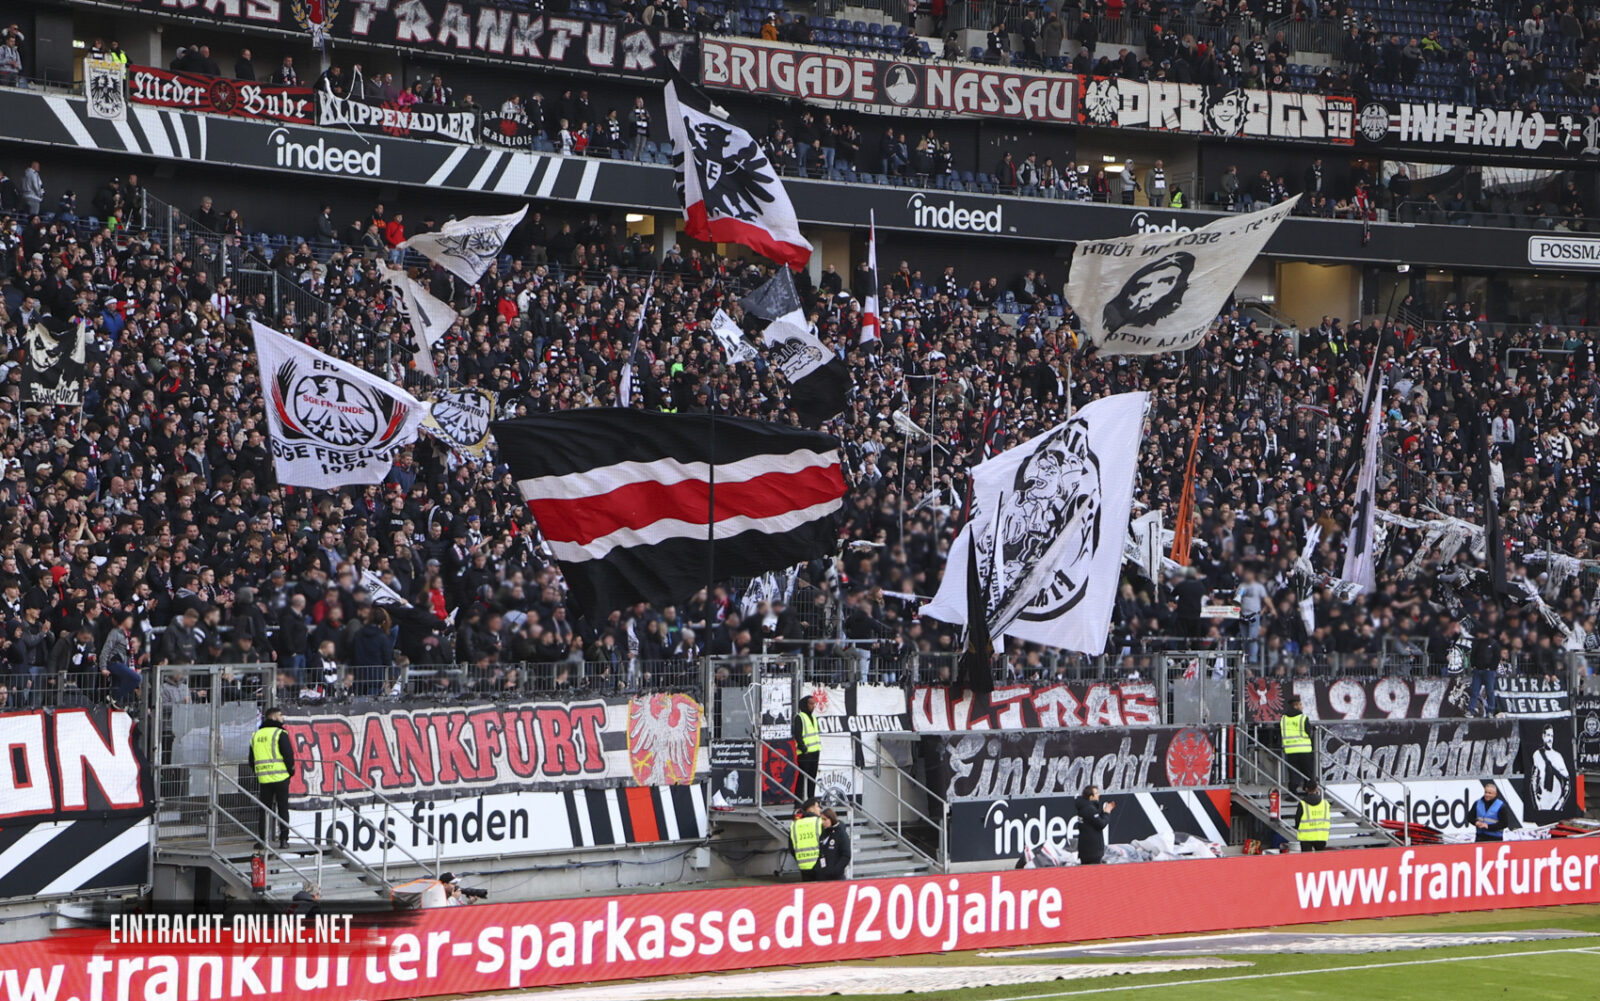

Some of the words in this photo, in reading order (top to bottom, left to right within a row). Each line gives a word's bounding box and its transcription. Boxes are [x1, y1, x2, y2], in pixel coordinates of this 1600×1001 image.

[351, 0, 695, 72] FRANKFURT
[240, 85, 308, 118] Bube
[703, 42, 877, 102] BRIGADE
[925, 67, 1074, 121] NASSAU
[318, 90, 475, 144] KLIPPENADLER
[834, 101, 951, 118] HOOLIGANS
[1328, 111, 1352, 138] 99
[1400, 103, 1546, 150] INFERNO
[274, 133, 382, 177] indeed
[913, 199, 1003, 233] indeed
[271, 438, 311, 461] SGE
[321, 459, 368, 475] 1994
[1293, 676, 1450, 720] 1997
[1498, 677, 1562, 691] ULTRAS
[1506, 698, 1562, 713] NEVER
[817, 715, 844, 733] OVA
[847, 714, 905, 732] GUARDIA
[911, 682, 1161, 732] ULTRAS
[286, 705, 607, 796] FRANKFURT
[945, 734, 1157, 798] Eintracht
[410, 798, 529, 847] finden
[993, 804, 1109, 855] inde
